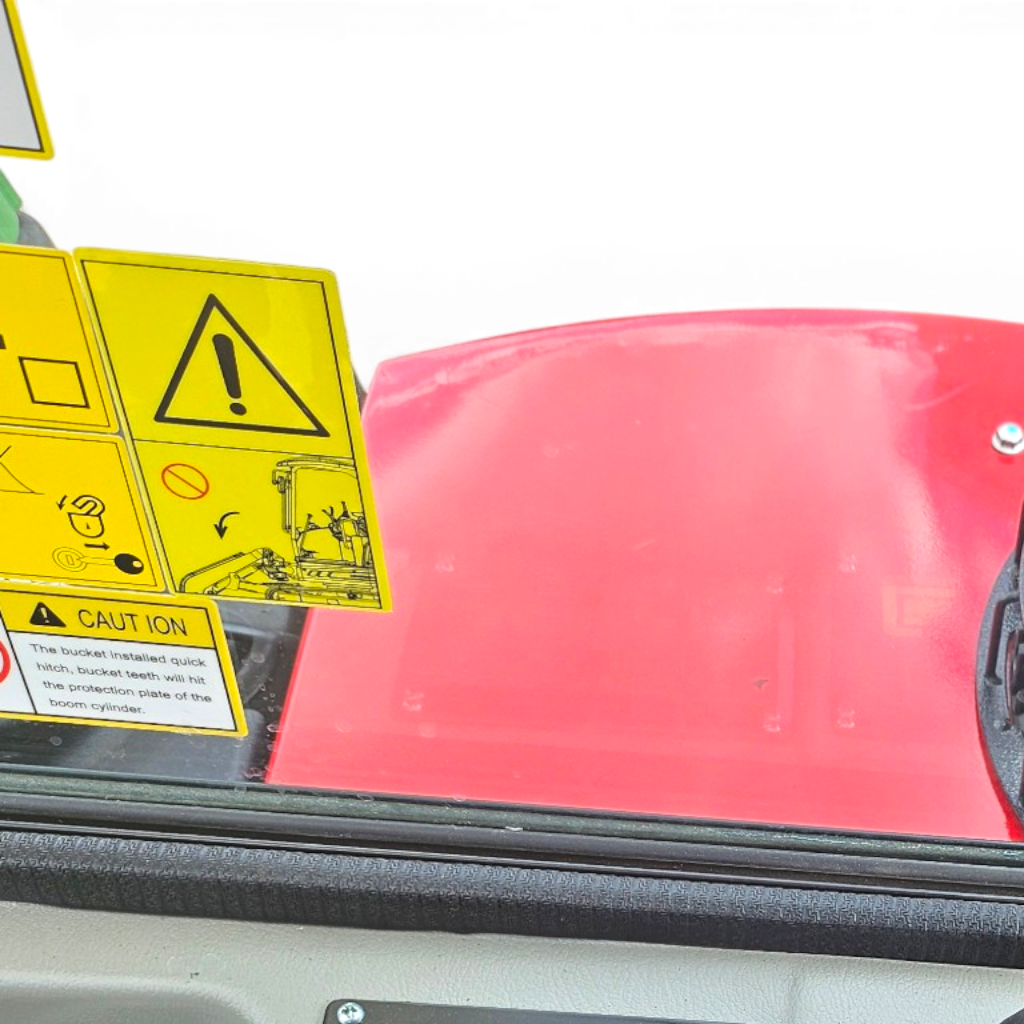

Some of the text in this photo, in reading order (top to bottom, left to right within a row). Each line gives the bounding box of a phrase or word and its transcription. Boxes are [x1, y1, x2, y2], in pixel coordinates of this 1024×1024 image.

[30, 643, 207, 668] The bucket installed quick
[36, 662, 206, 686] hitch, bucket teeth will hit
[42, 680, 212, 703] the protection plate of the
[50, 699, 146, 715] boom cylinder.
